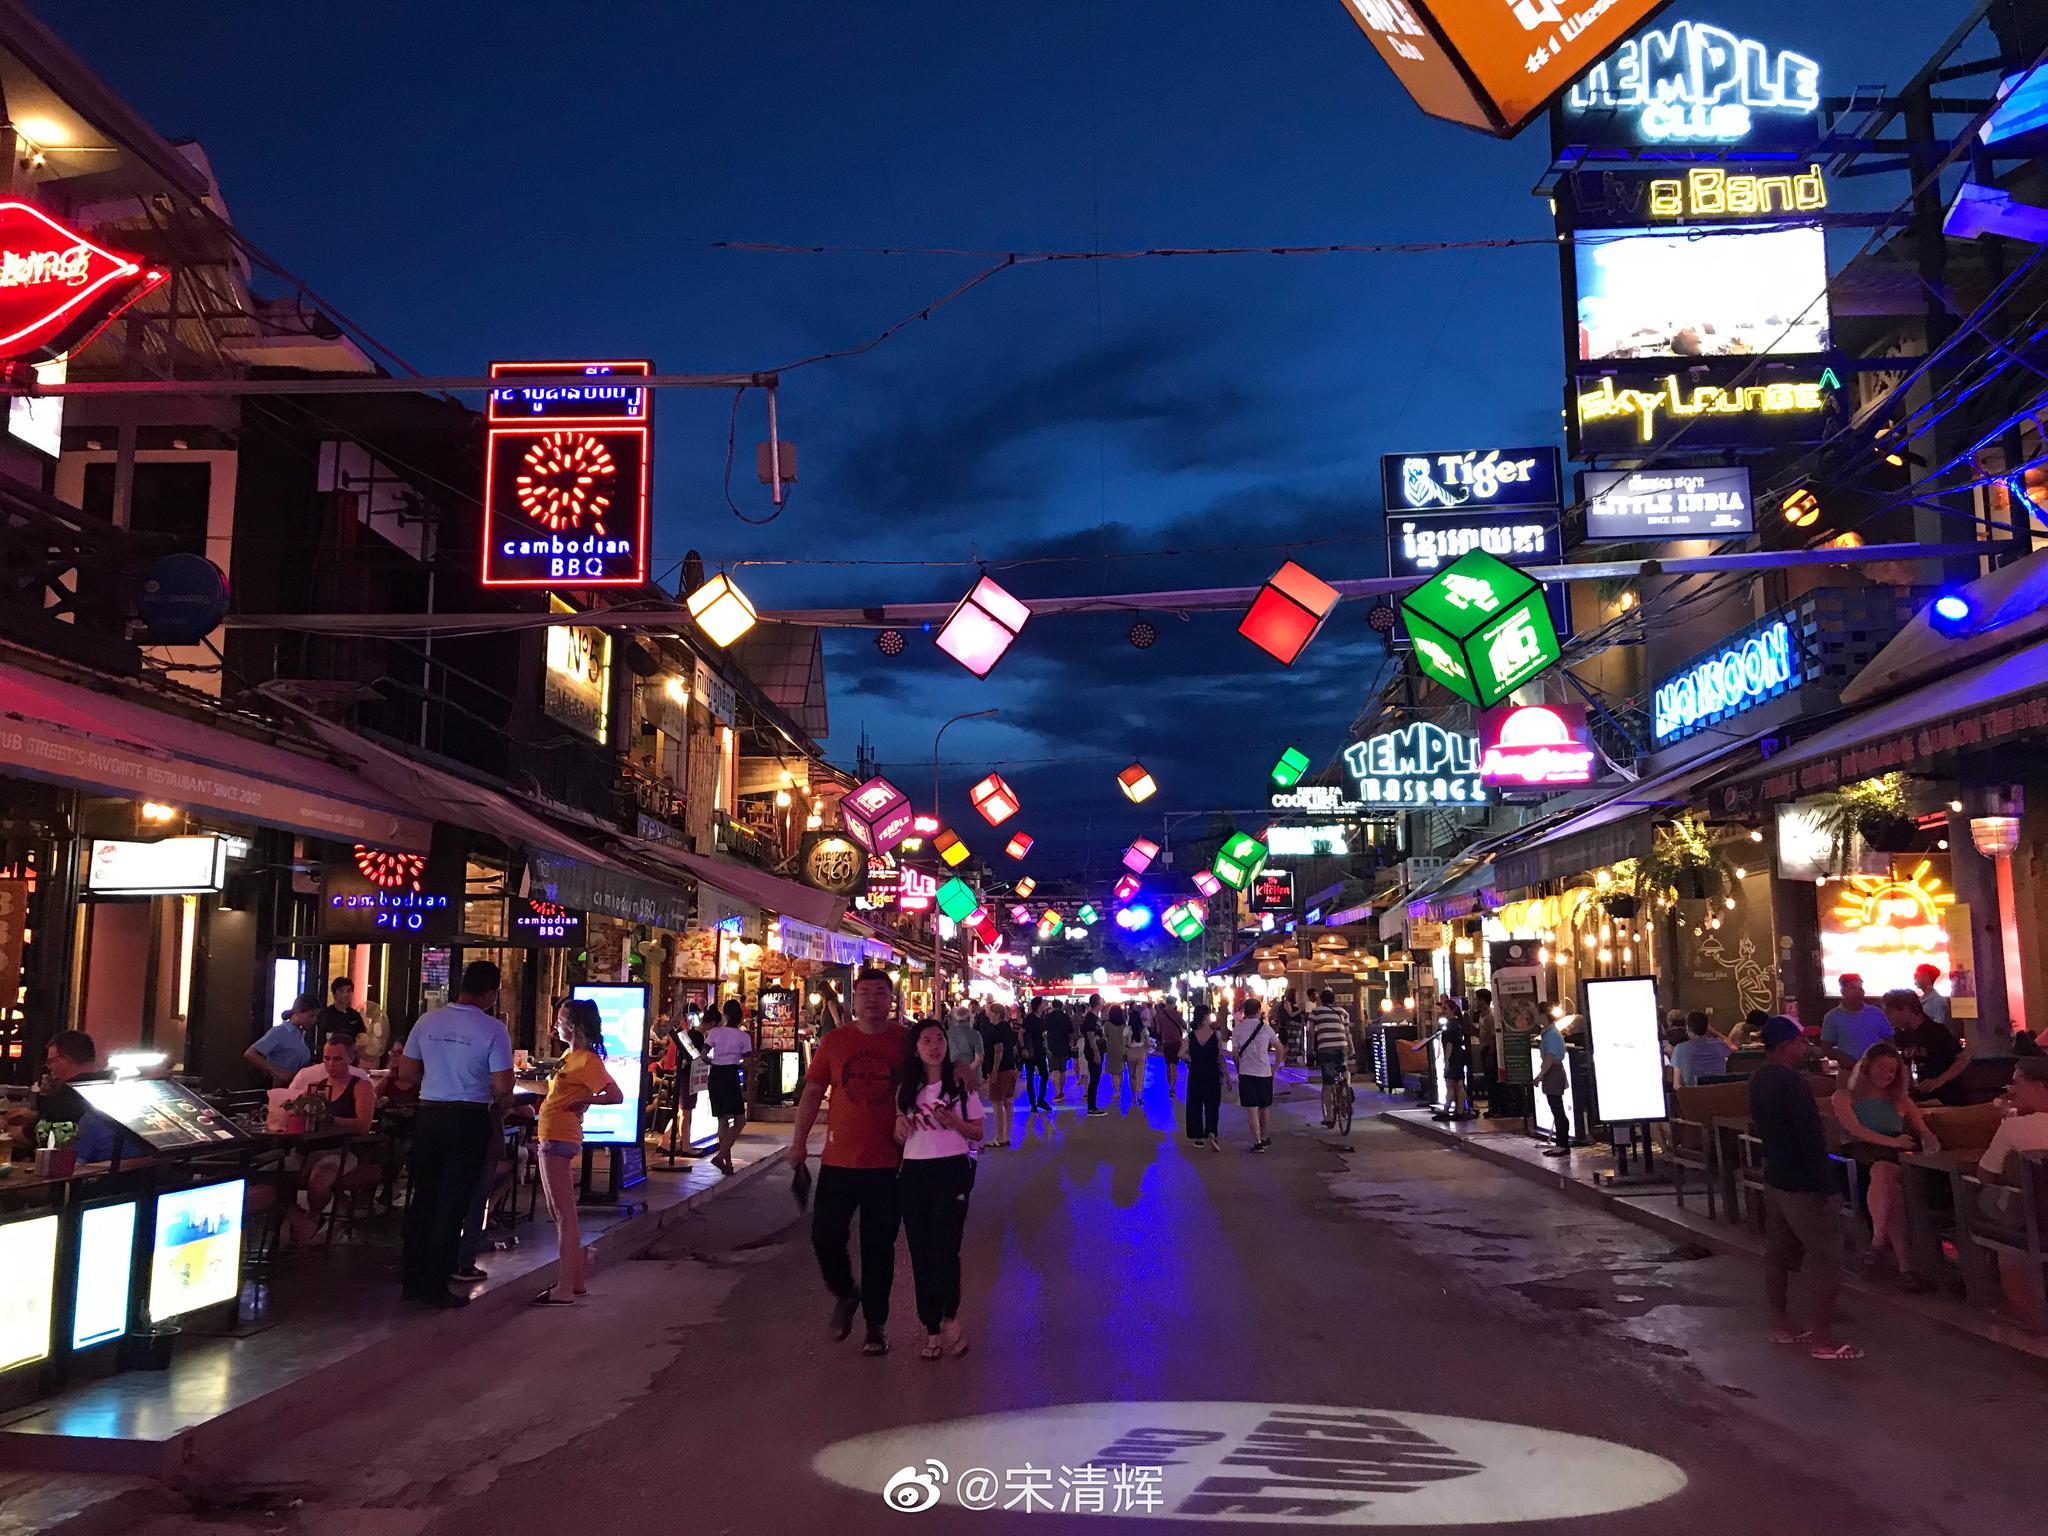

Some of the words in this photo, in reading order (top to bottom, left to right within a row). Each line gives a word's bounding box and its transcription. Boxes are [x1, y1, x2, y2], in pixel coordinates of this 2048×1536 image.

[1688, 164, 1828, 213] Band
[1437, 450, 1536, 498] Tiger
[1592, 494, 1674, 516] LITTLE
[1678, 491, 1745, 514] INDIA
[503, 535, 630, 555] cambodian
[551, 557, 603, 577] BBQ
[1655, 622, 1791, 739] MONSOON
[0, 731, 22, 750] UB
[1343, 721, 1482, 778] TEMPL
[1359, 778, 1487, 802] MASSAGE
[517, 915, 578, 925] cambodian
[539, 926, 564, 936] BBQ
